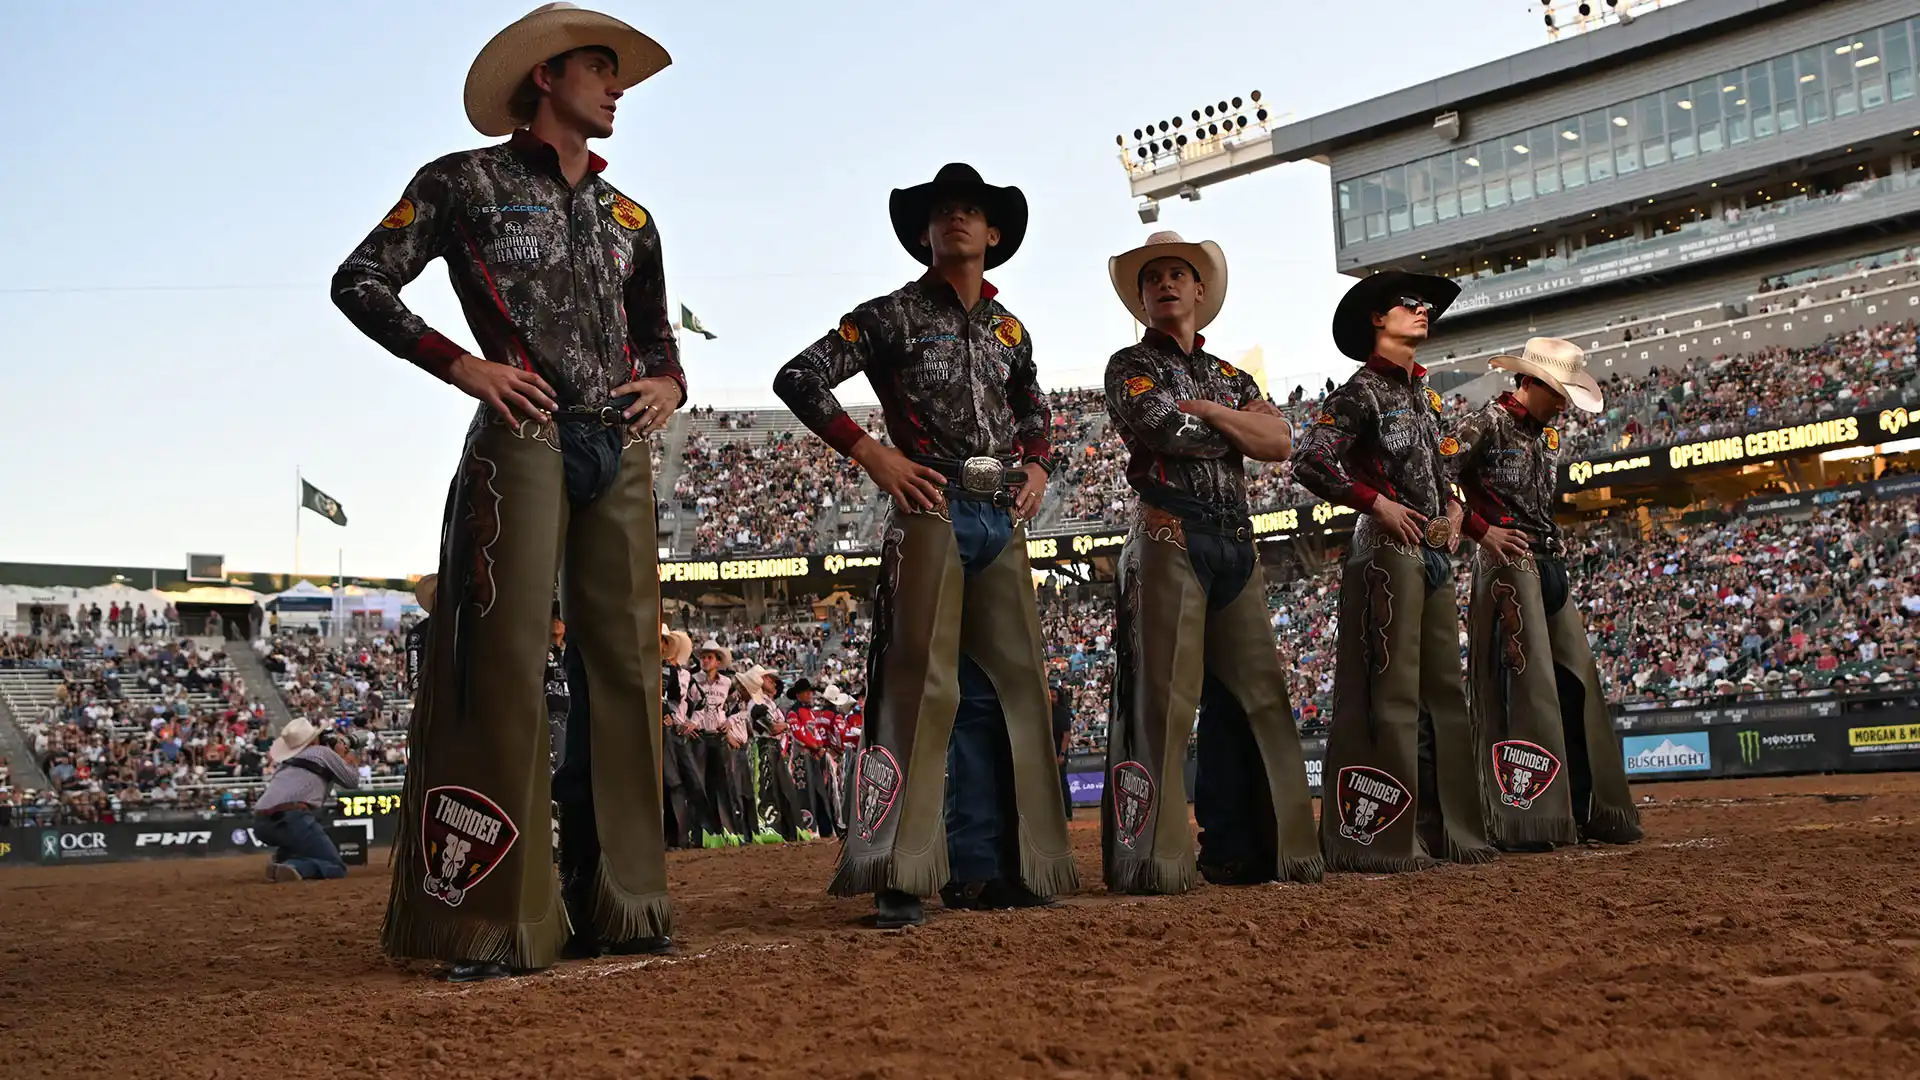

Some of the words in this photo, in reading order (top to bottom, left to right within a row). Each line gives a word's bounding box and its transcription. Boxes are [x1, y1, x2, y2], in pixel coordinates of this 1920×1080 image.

[494, 236, 538, 251] REDHEAD
[496, 247, 540, 262] RANCH
[1498, 285, 1533, 300] SUITE
[1537, 277, 1574, 291] LEVEL
[1593, 456, 1650, 475] RAM
[1669, 435, 1744, 469] OPENING
[1745, 416, 1859, 457] CEREMONIES
[659, 562, 719, 582] OPENING
[720, 557, 809, 580] CEREMONIES
[1855, 730, 1897, 743] MORGAN
[1900, 729, 1907, 739] &
[1502, 746, 1551, 772] THUNDER
[862, 754, 895, 790] THUNDER
[1120, 769, 1150, 798] THUNDER
[1348, 772, 1401, 806] THUNDER
[435, 794, 502, 846] THUNDER
[60, 832, 107, 849] OCR
